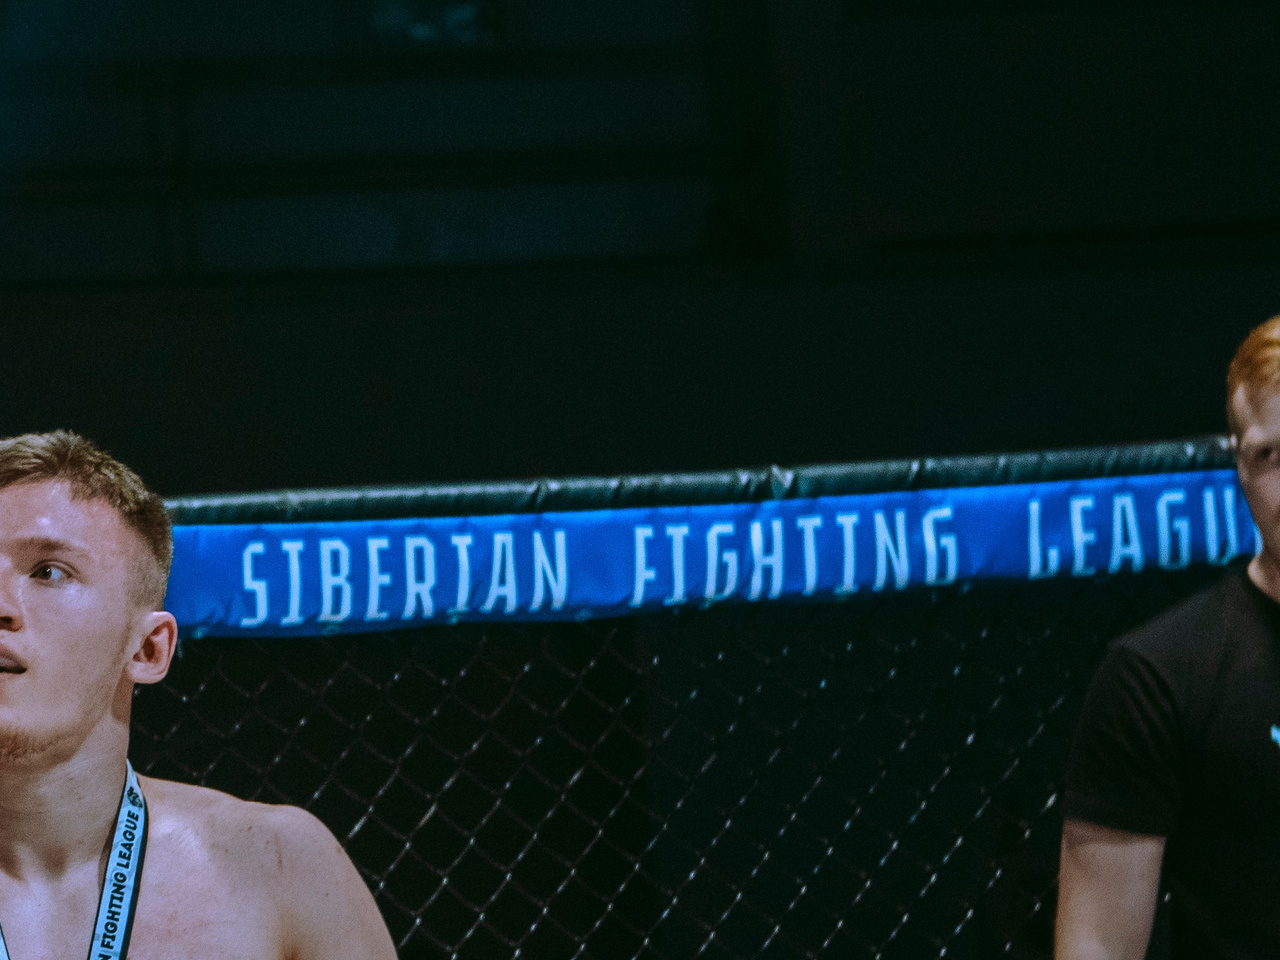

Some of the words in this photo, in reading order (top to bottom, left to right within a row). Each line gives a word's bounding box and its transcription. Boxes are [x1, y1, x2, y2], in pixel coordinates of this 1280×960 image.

[240, 529, 567, 628] SIBERIAN
[630, 506, 958, 608] FIGHTING
[1028, 485, 1264, 580] LEAGU
[101, 871, 127, 950] FIGHTING
[118, 810, 140, 870] LEAGUE
